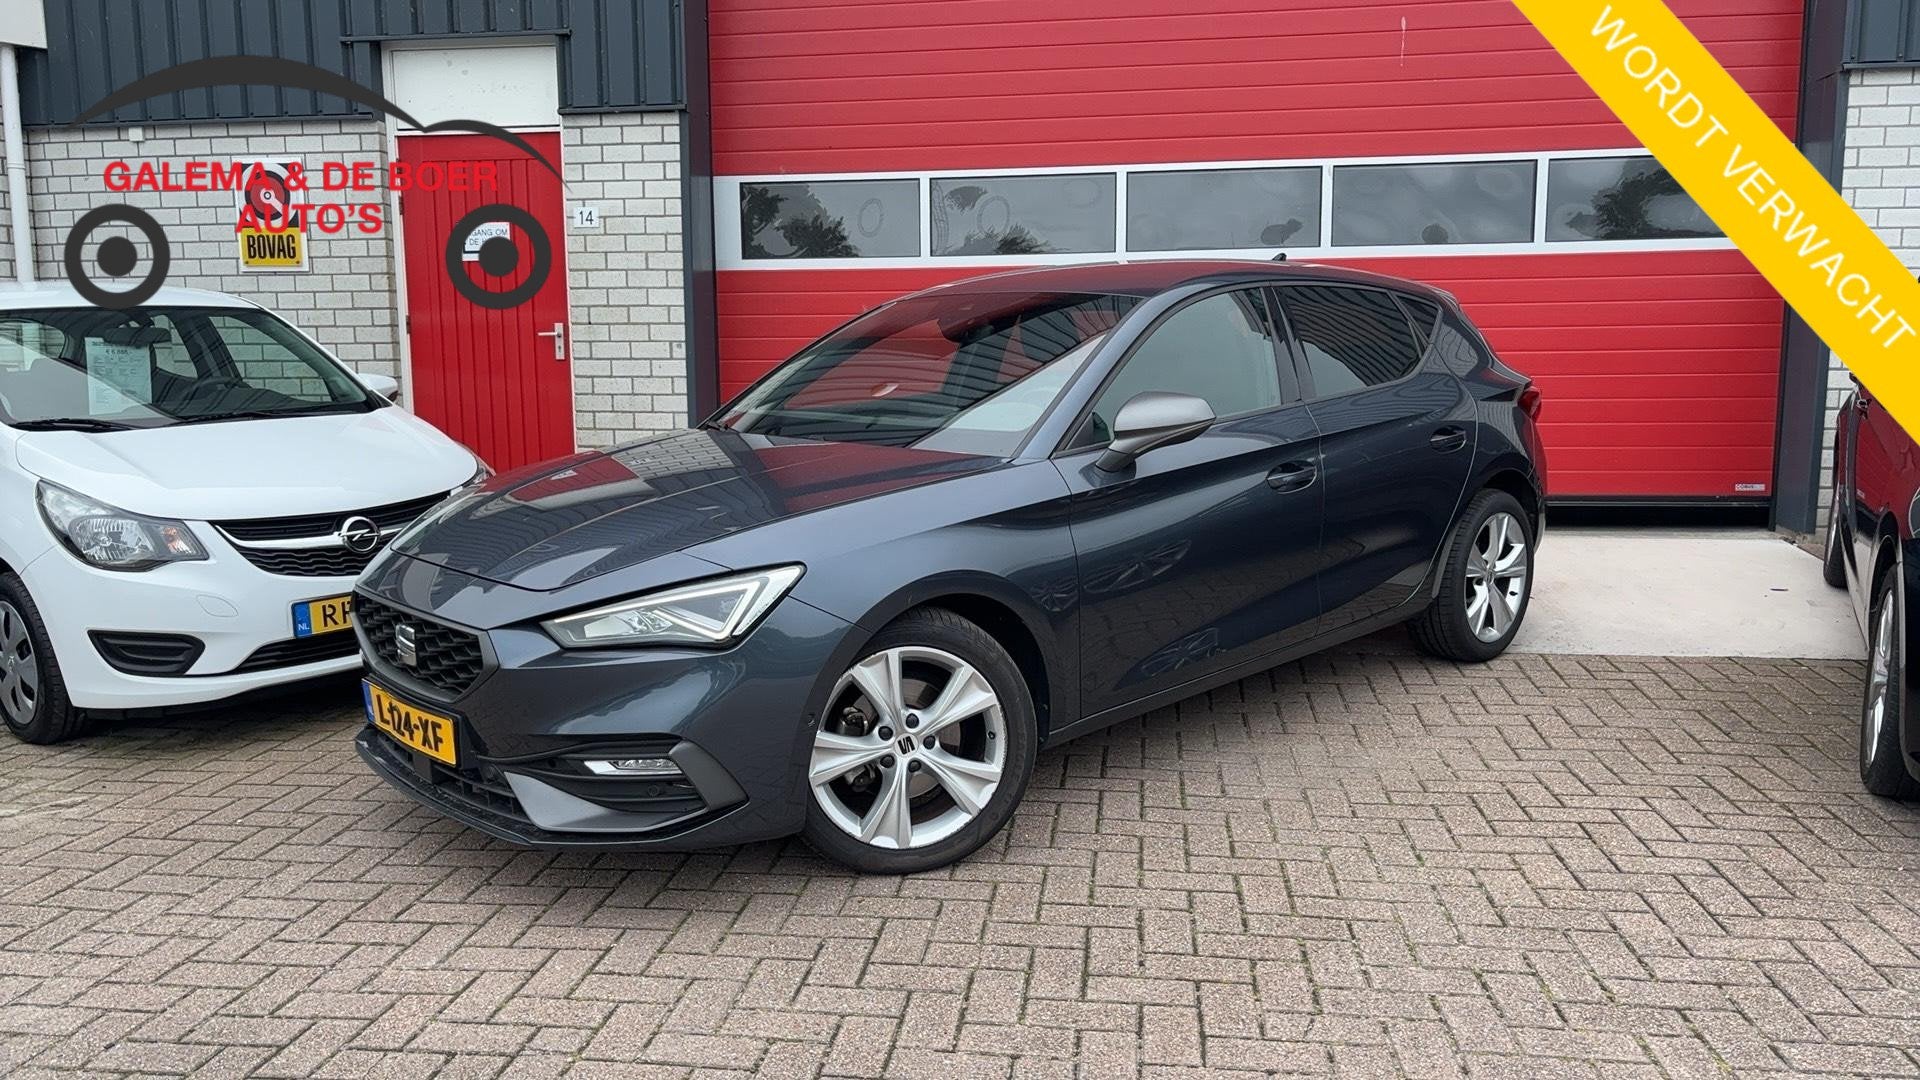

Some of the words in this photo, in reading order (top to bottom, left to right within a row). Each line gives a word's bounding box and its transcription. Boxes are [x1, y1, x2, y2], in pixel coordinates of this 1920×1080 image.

[579, 210, 594, 225] 14
[246, 234, 297, 259] BOVAG
[297, 622, 310, 631] NL
